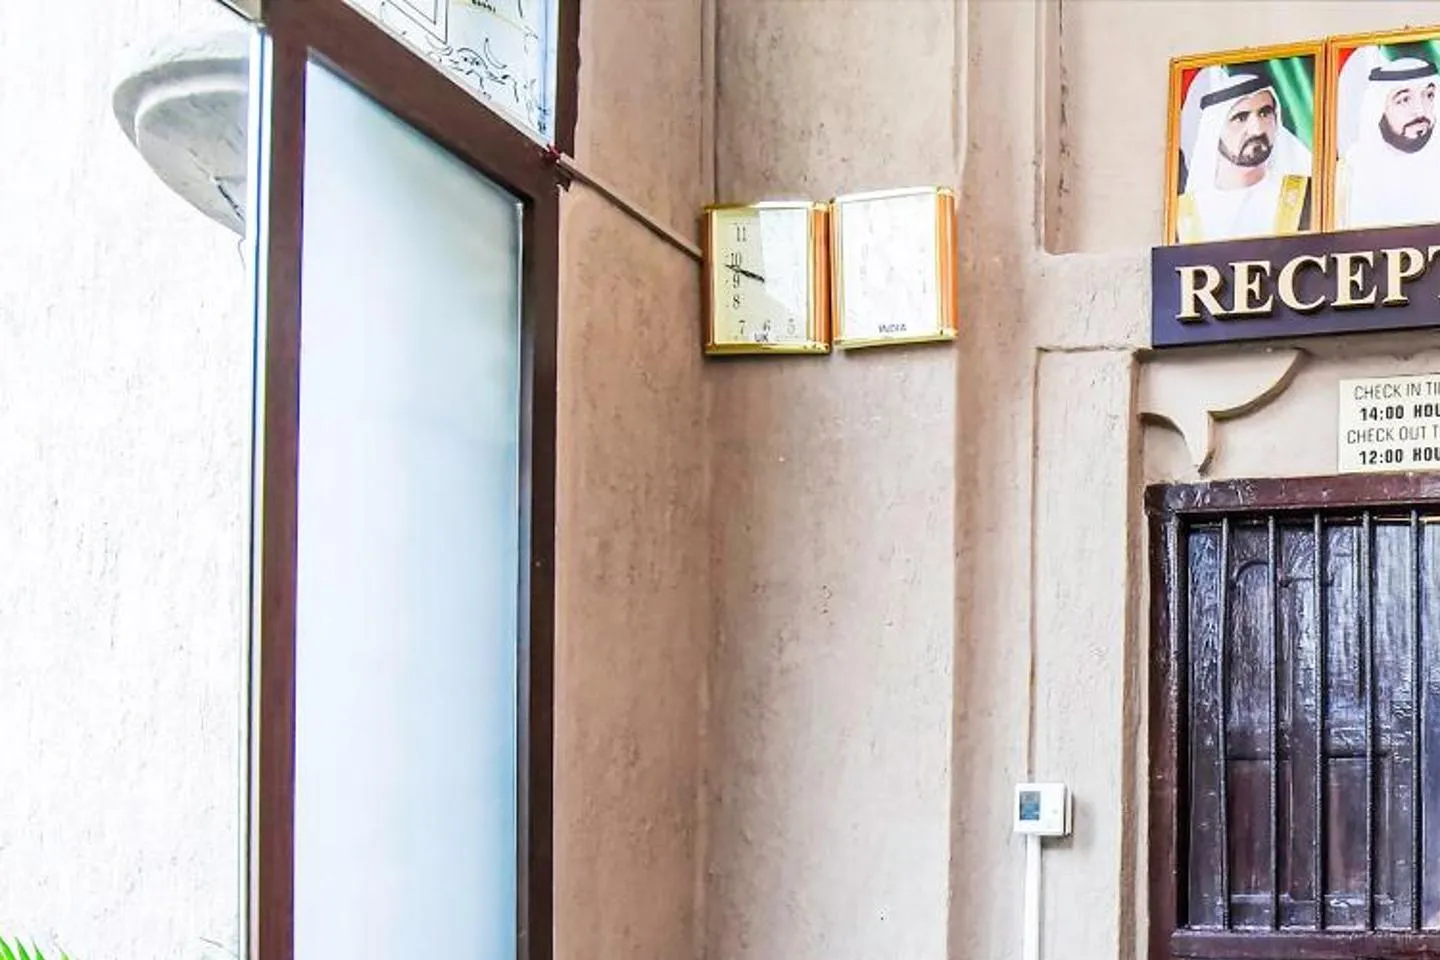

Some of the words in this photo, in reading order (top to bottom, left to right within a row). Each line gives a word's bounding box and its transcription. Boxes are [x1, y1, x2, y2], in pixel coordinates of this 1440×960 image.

[1353, 383, 1402, 400] CHECK
[1405, 382, 1421, 397] IN
[1360, 404, 1404, 421] 14:00
[1347, 427, 1394, 444] CHECK
[1399, 425, 1426, 441] OUT
[1359, 448, 1404, 465] 12:00
